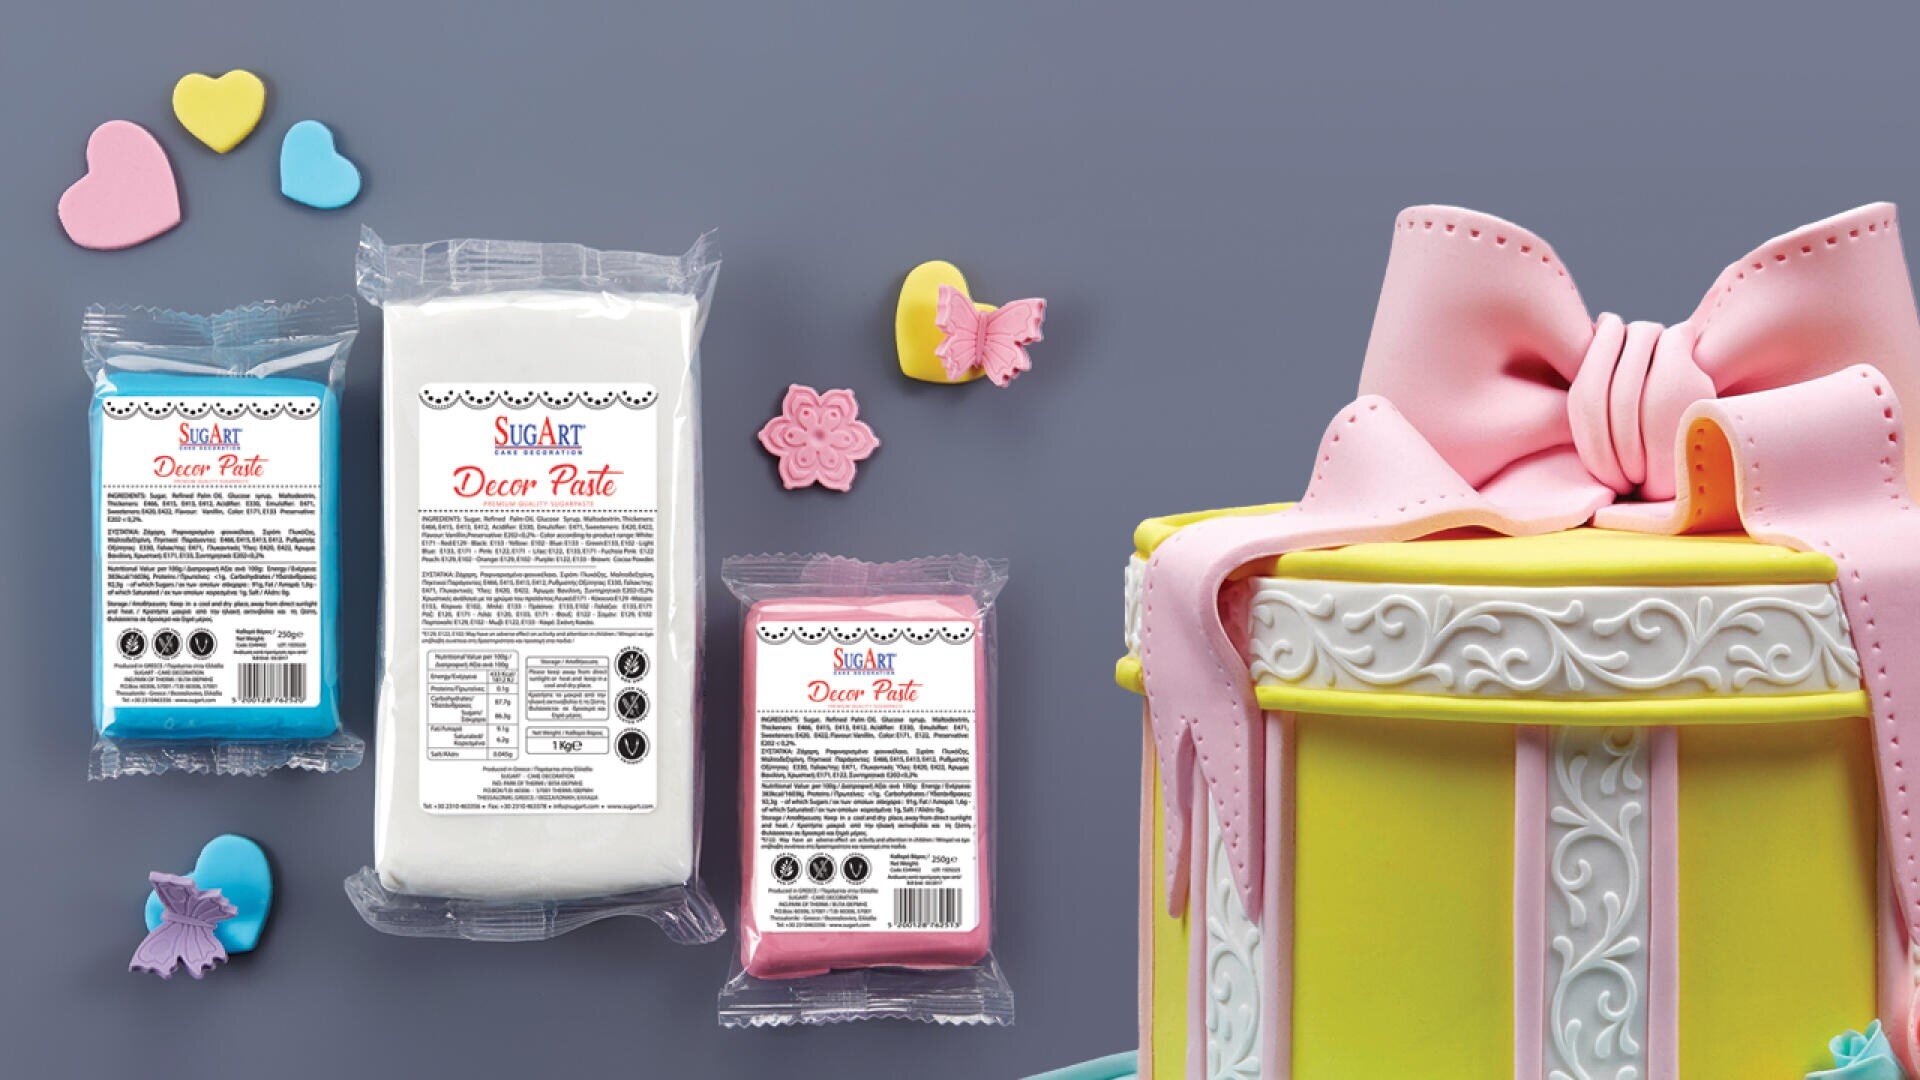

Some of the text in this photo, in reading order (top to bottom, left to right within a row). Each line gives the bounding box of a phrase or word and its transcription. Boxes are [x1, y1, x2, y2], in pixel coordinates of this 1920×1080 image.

[154, 454, 269, 477] Decor Paste
[453, 464, 624, 498] Decor Paste
[808, 679, 923, 703] Decor Paste
